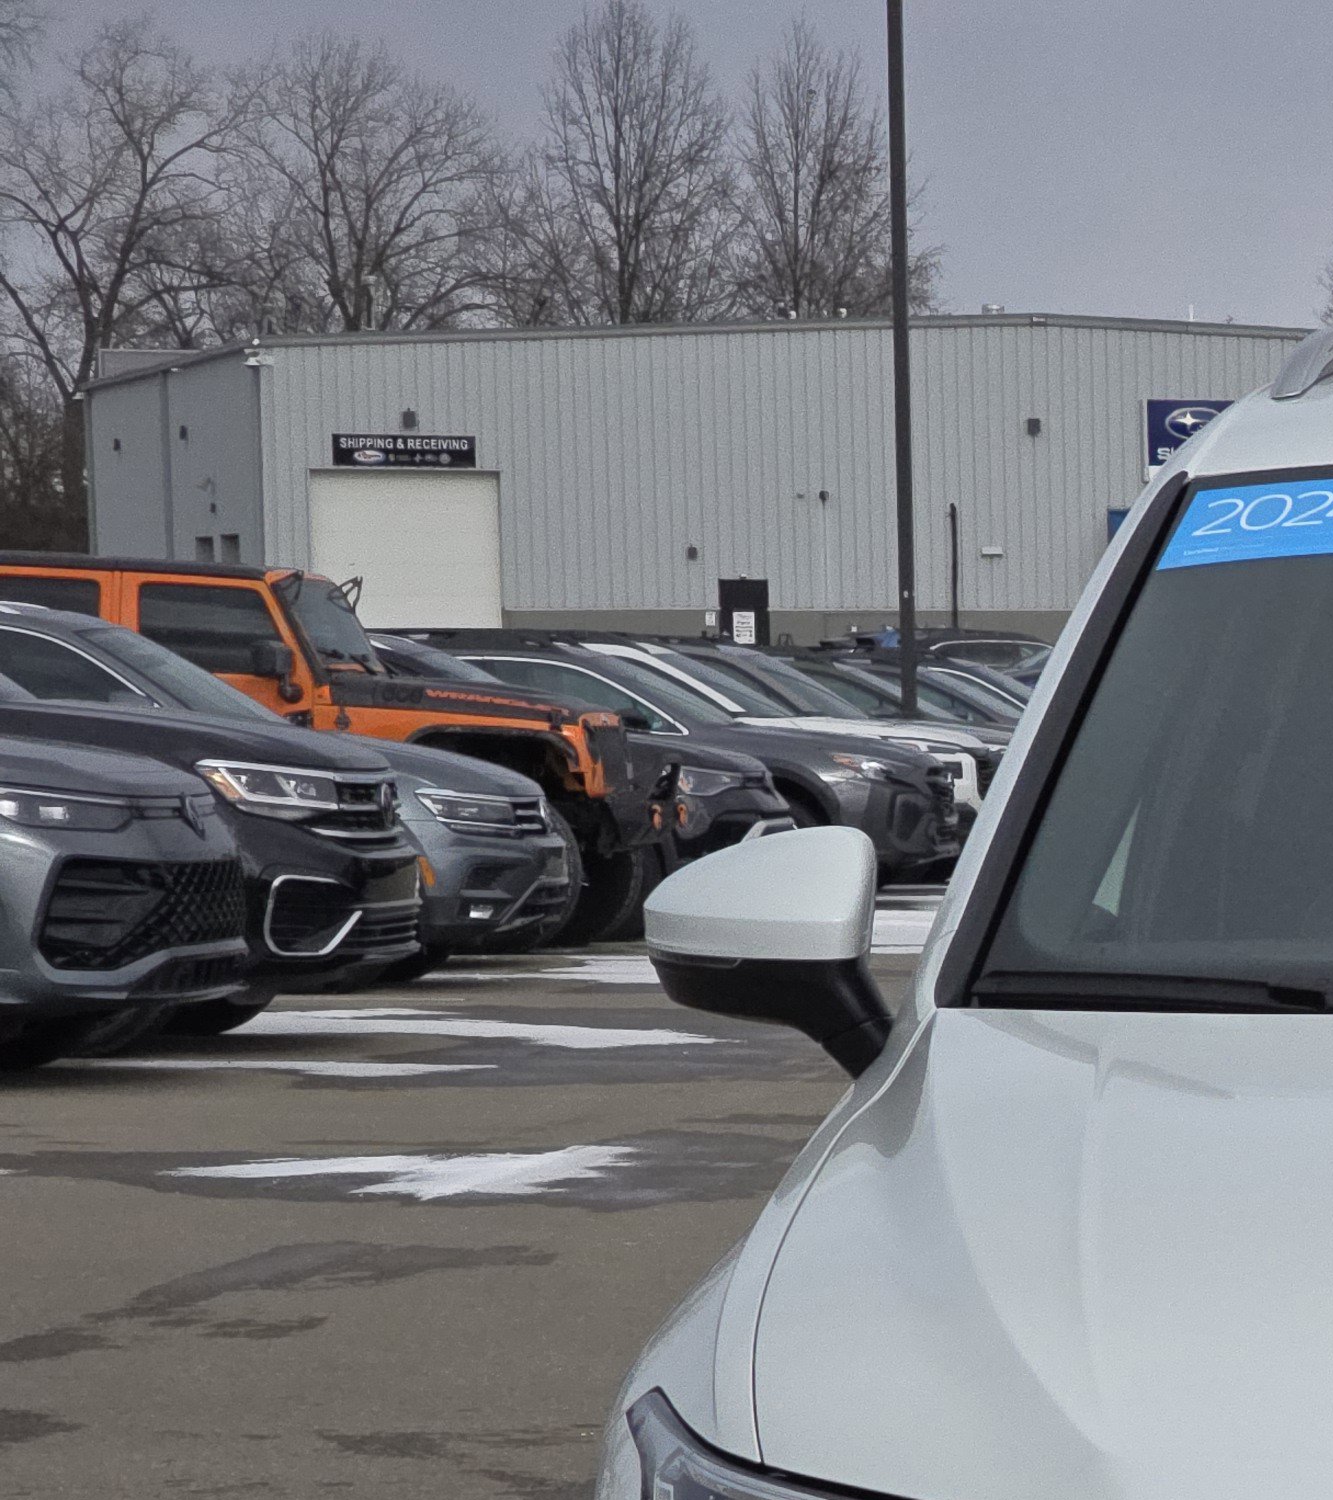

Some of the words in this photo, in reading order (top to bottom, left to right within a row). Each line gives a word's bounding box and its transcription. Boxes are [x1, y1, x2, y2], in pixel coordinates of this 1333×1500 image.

[339, 437, 394, 449] SHIPPING
[396, 438, 405, 449] &
[407, 439, 469, 451] RECEIVING
